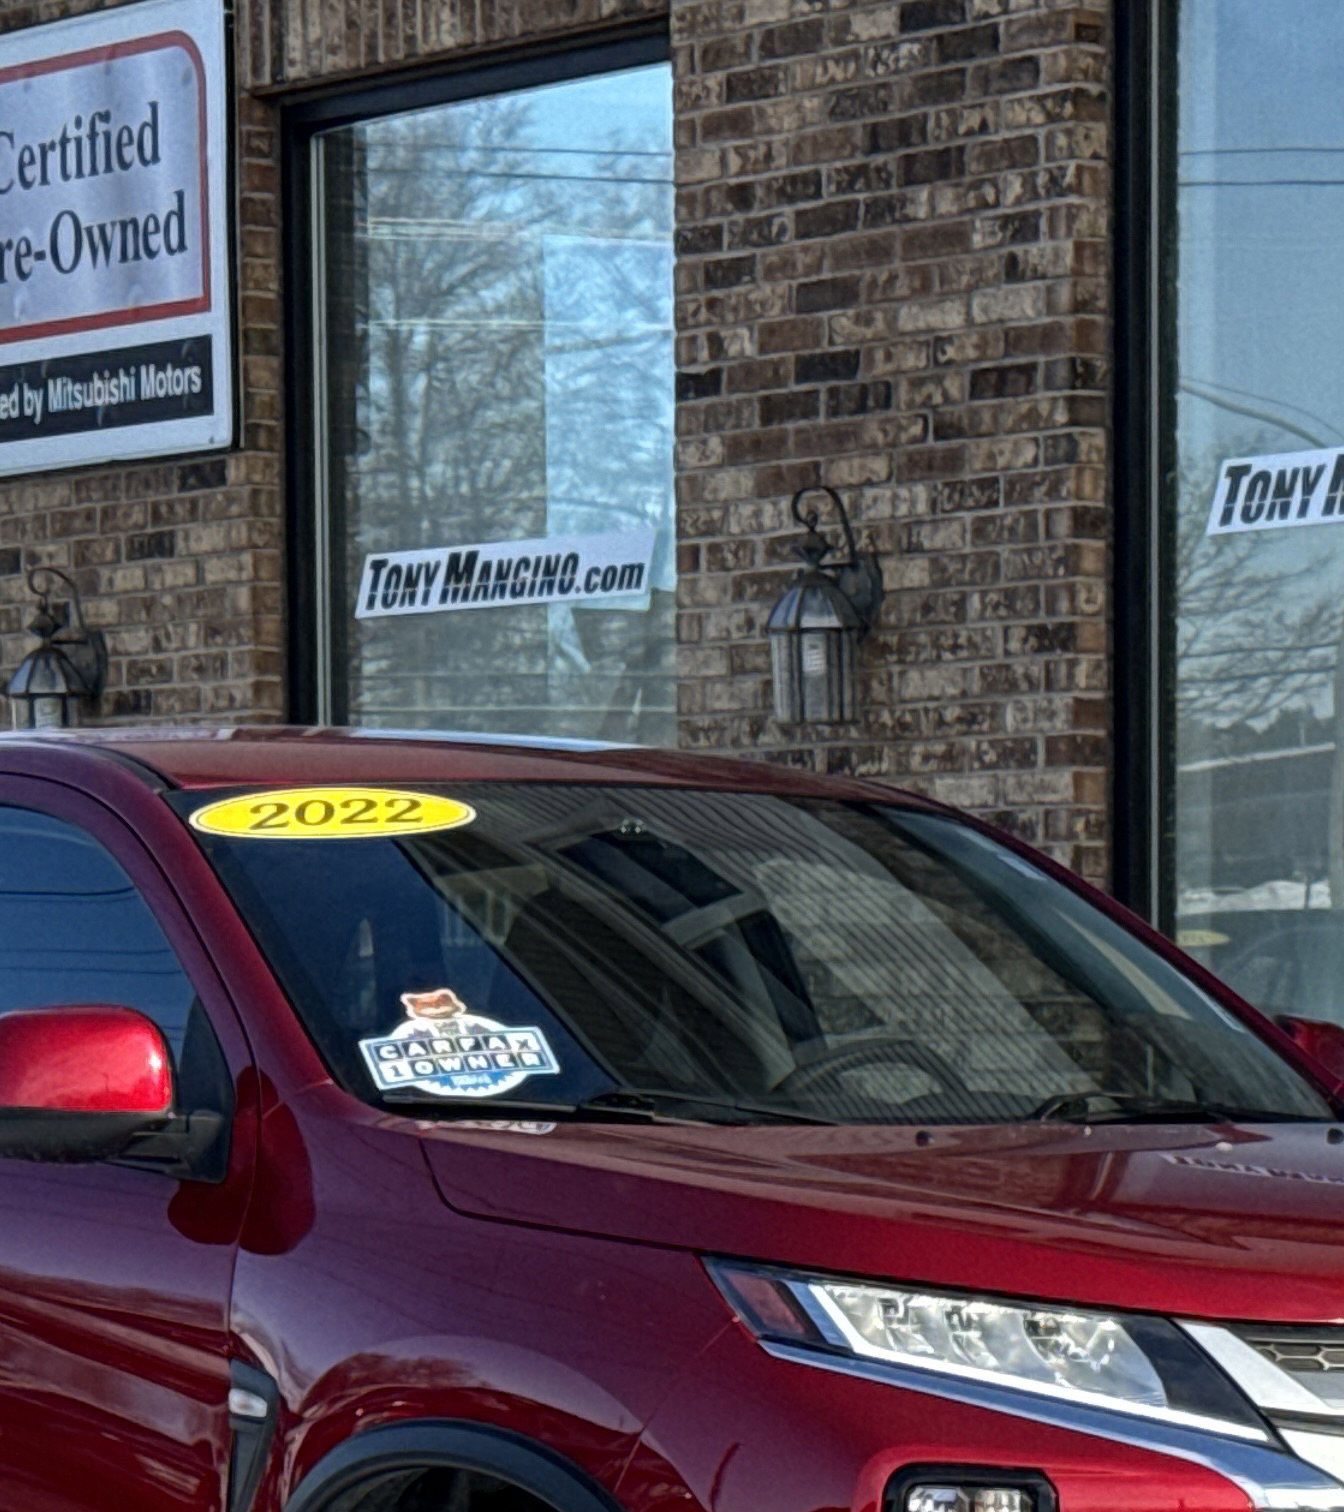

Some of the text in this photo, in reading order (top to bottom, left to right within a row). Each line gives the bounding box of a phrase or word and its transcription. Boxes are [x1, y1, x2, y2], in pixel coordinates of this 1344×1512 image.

[23, 382, 45, 424] by
[47, 366, 137, 413] Mitsubishi
[140, 364, 202, 404] Motors
[248, 798, 424, 831] 2022
[378, 1035, 532, 1060] CARFAX
[414, 1052, 542, 1076] OWNER
